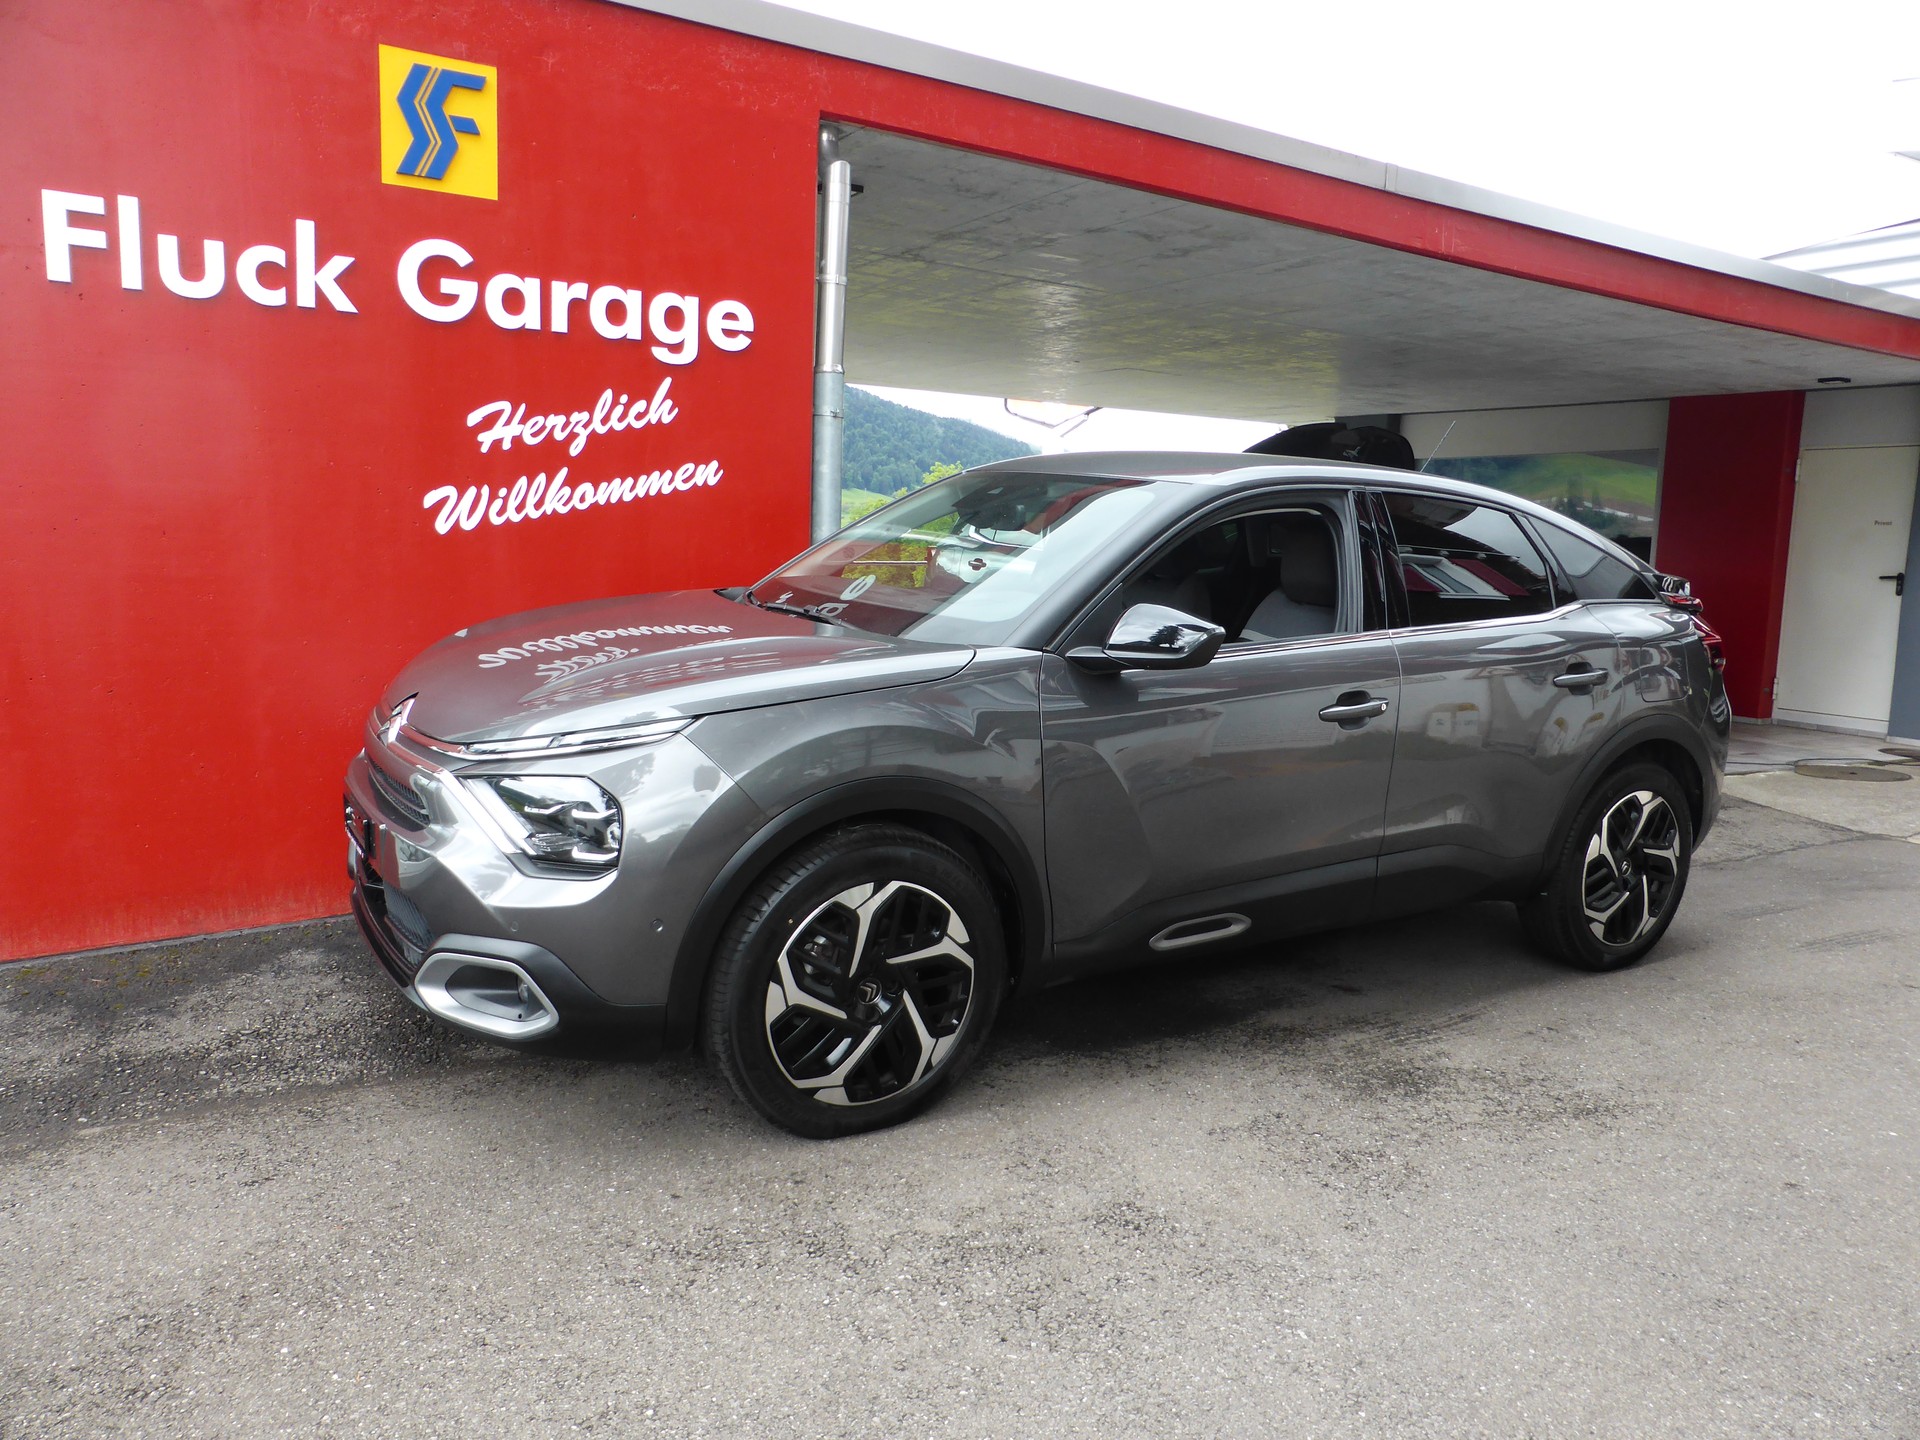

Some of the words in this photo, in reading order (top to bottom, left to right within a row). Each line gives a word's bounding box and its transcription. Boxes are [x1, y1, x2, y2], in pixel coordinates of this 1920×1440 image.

[40, 187, 359, 314] Fluck
[397, 238, 755, 366] Garage
[466, 376, 679, 457] Herzlich
[422, 459, 724, 535] Willkommen
